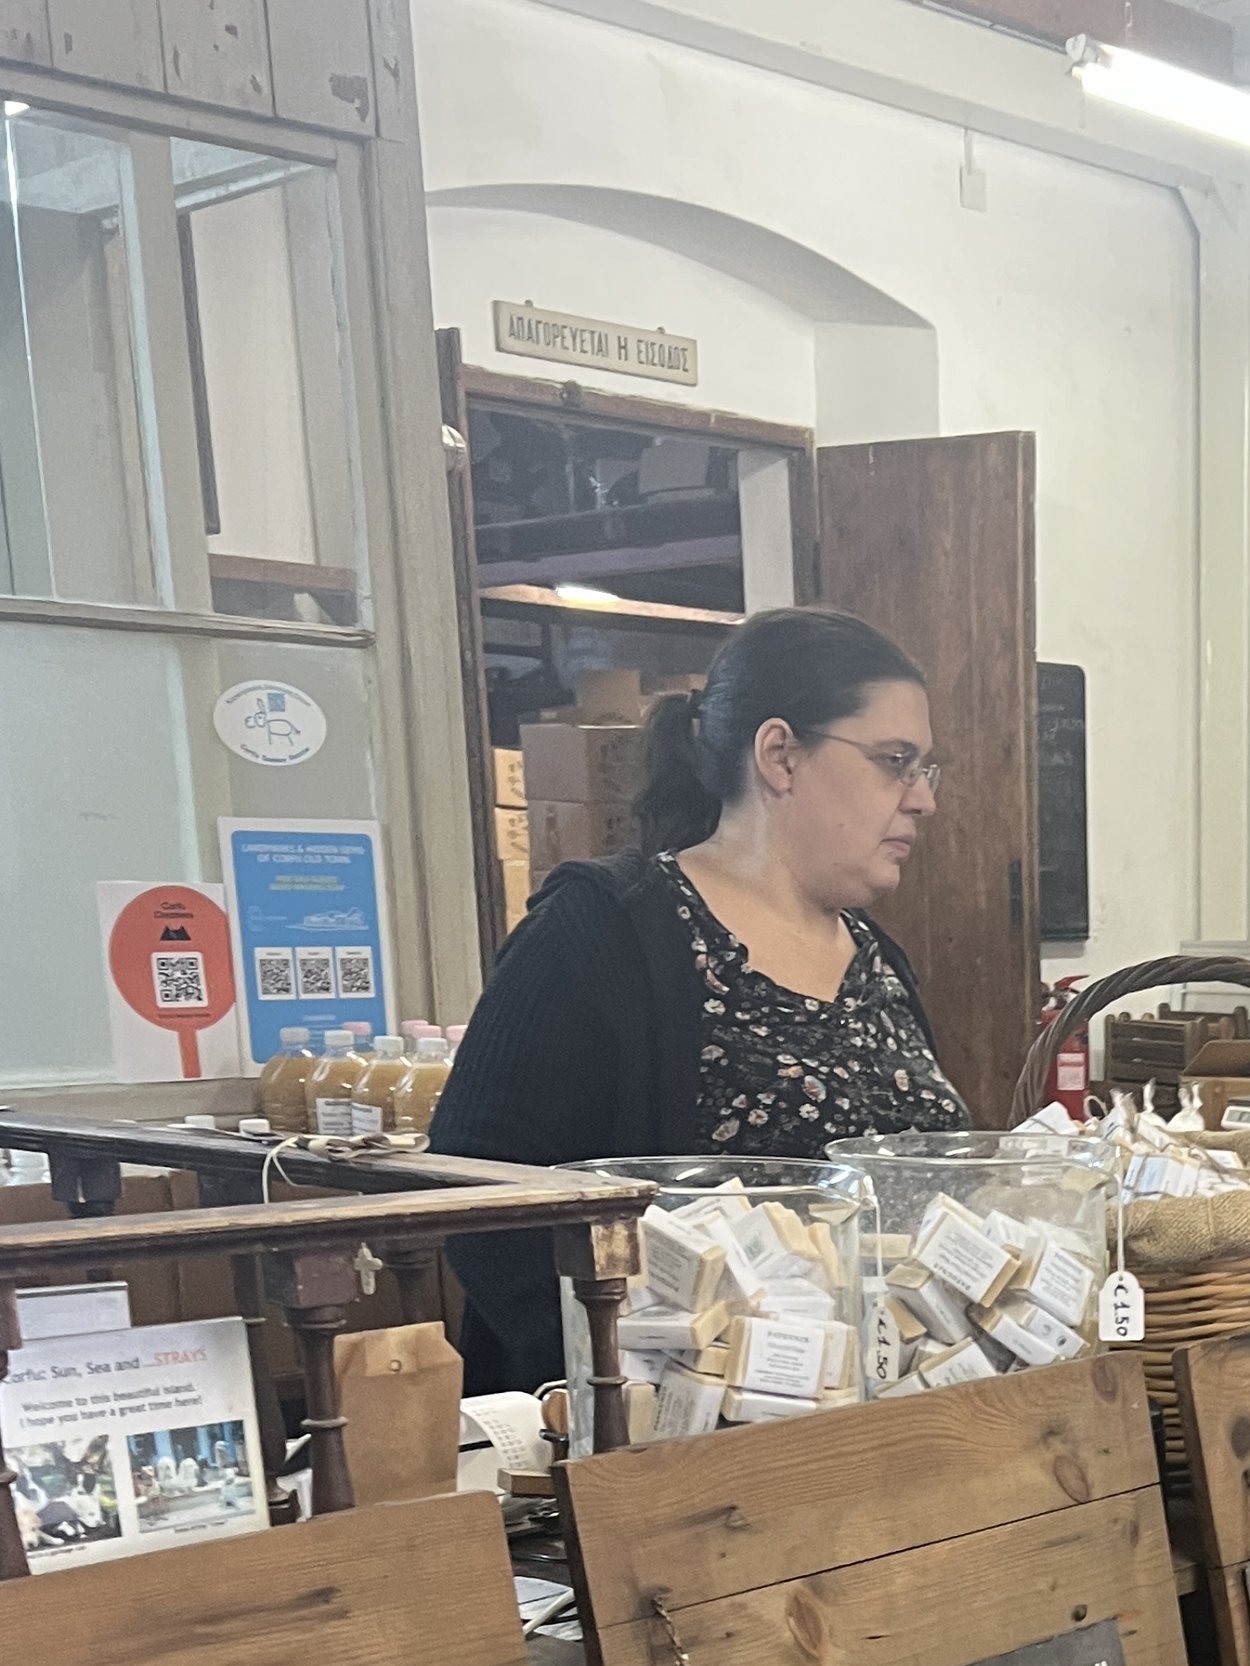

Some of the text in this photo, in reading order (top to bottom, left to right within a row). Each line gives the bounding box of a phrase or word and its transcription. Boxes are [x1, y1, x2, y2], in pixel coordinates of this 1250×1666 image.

[508, 314, 690, 373] ΑΠΑΓΟΡΕΥΕΤΑΙ Η ΕΙΣΟΔΟΣ
[86, 1361, 111, 1375] Sea
[114, 1357, 140, 1372] and
